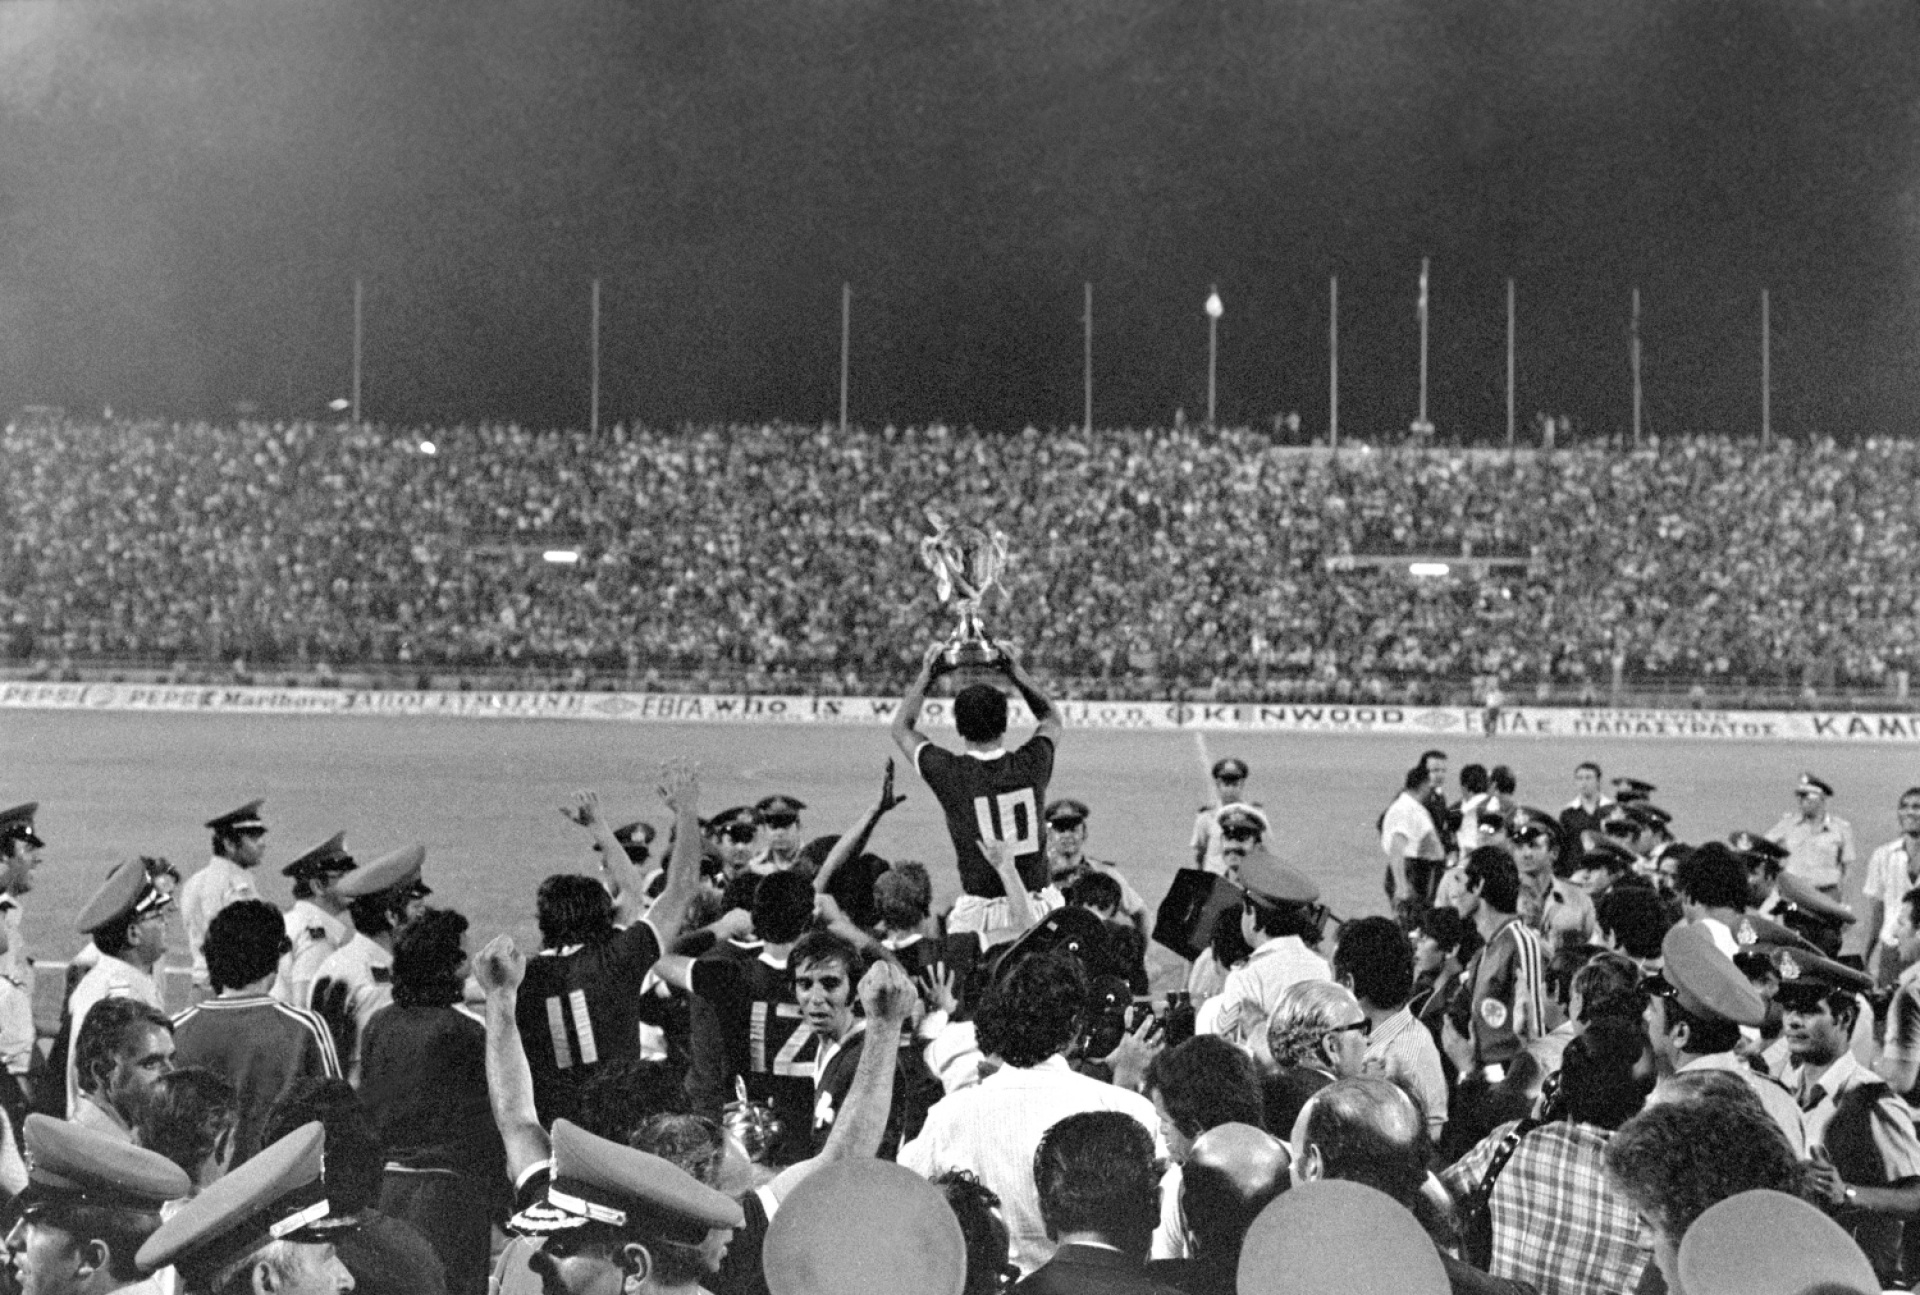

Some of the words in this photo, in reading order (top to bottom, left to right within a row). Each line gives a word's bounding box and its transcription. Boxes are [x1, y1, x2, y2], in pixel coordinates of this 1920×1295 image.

[220, 691, 337, 708] Marlboro
[974, 787, 1039, 857] 10
[546, 988, 599, 1070] 11
[750, 1001, 822, 1077] 12
